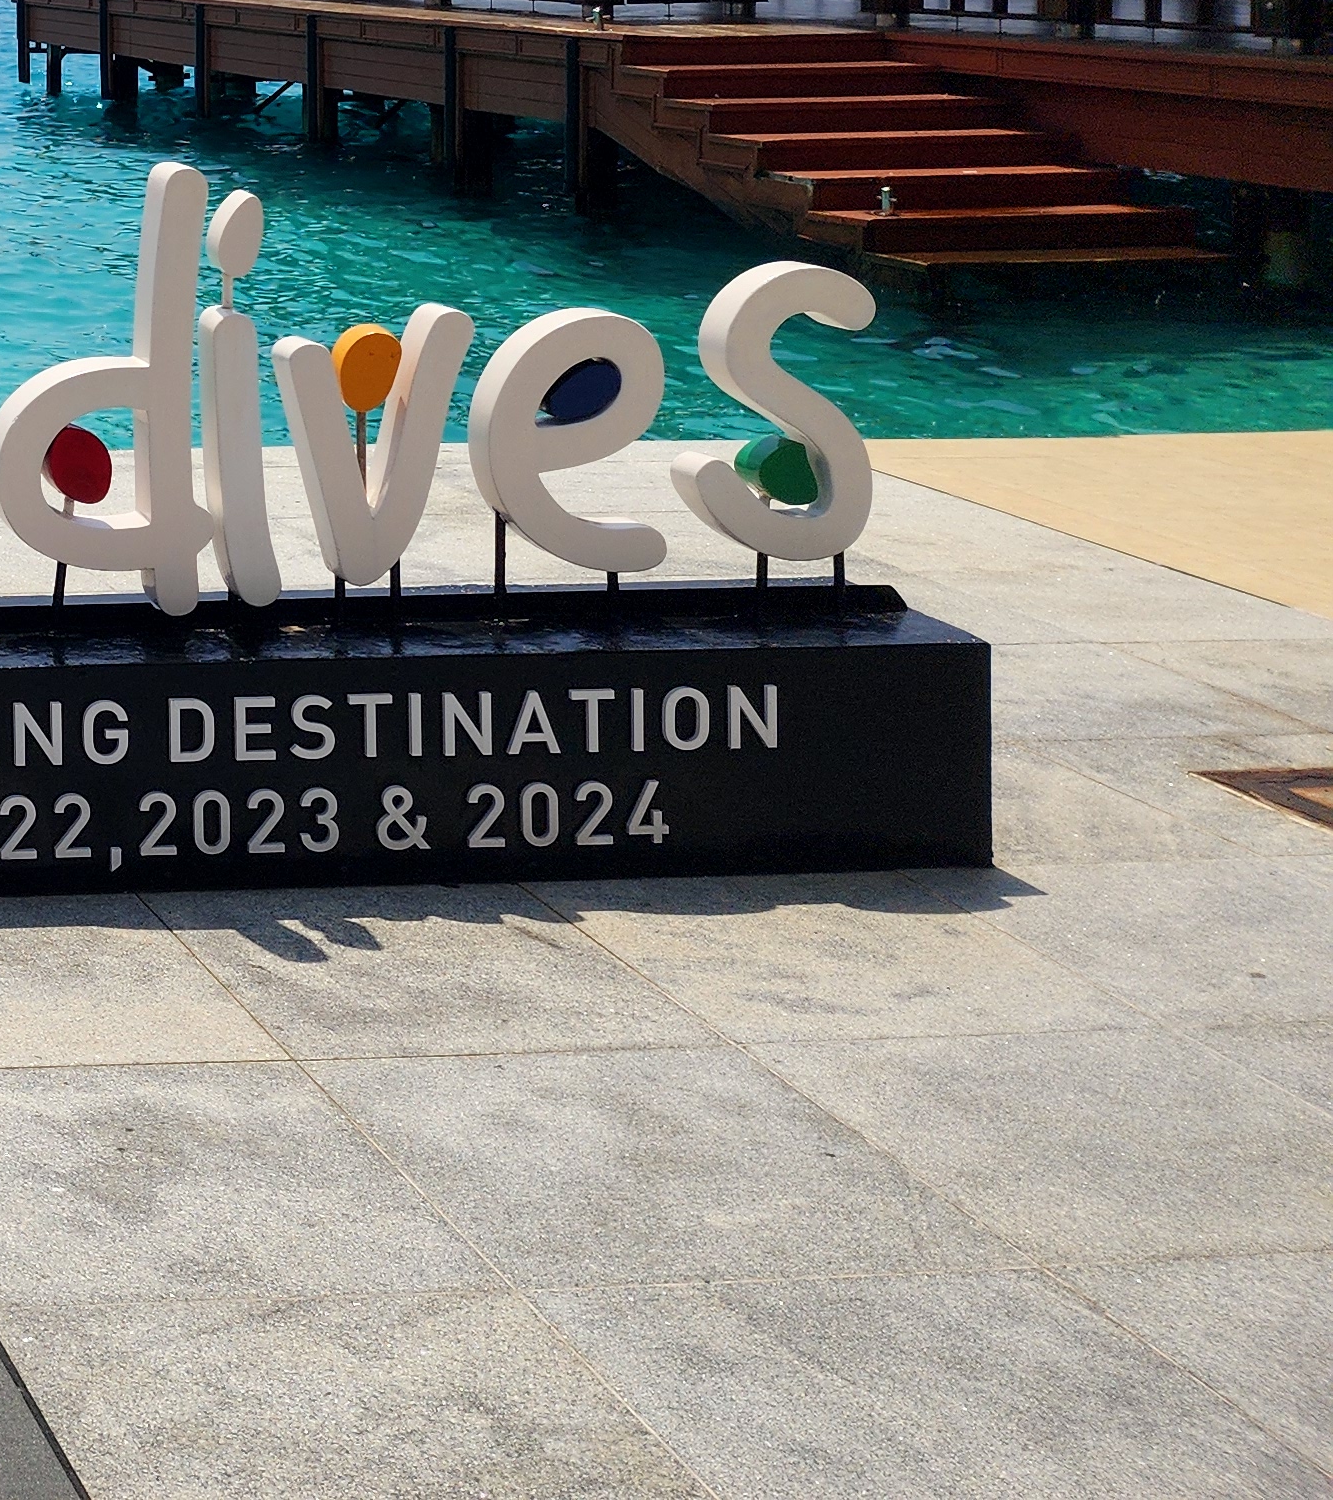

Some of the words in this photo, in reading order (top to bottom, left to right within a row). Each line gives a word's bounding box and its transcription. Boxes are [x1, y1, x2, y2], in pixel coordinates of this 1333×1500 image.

[168, 684, 779, 763] DESTINATION
[376, 784, 432, 851] &
[466, 778, 671, 848] 2024
